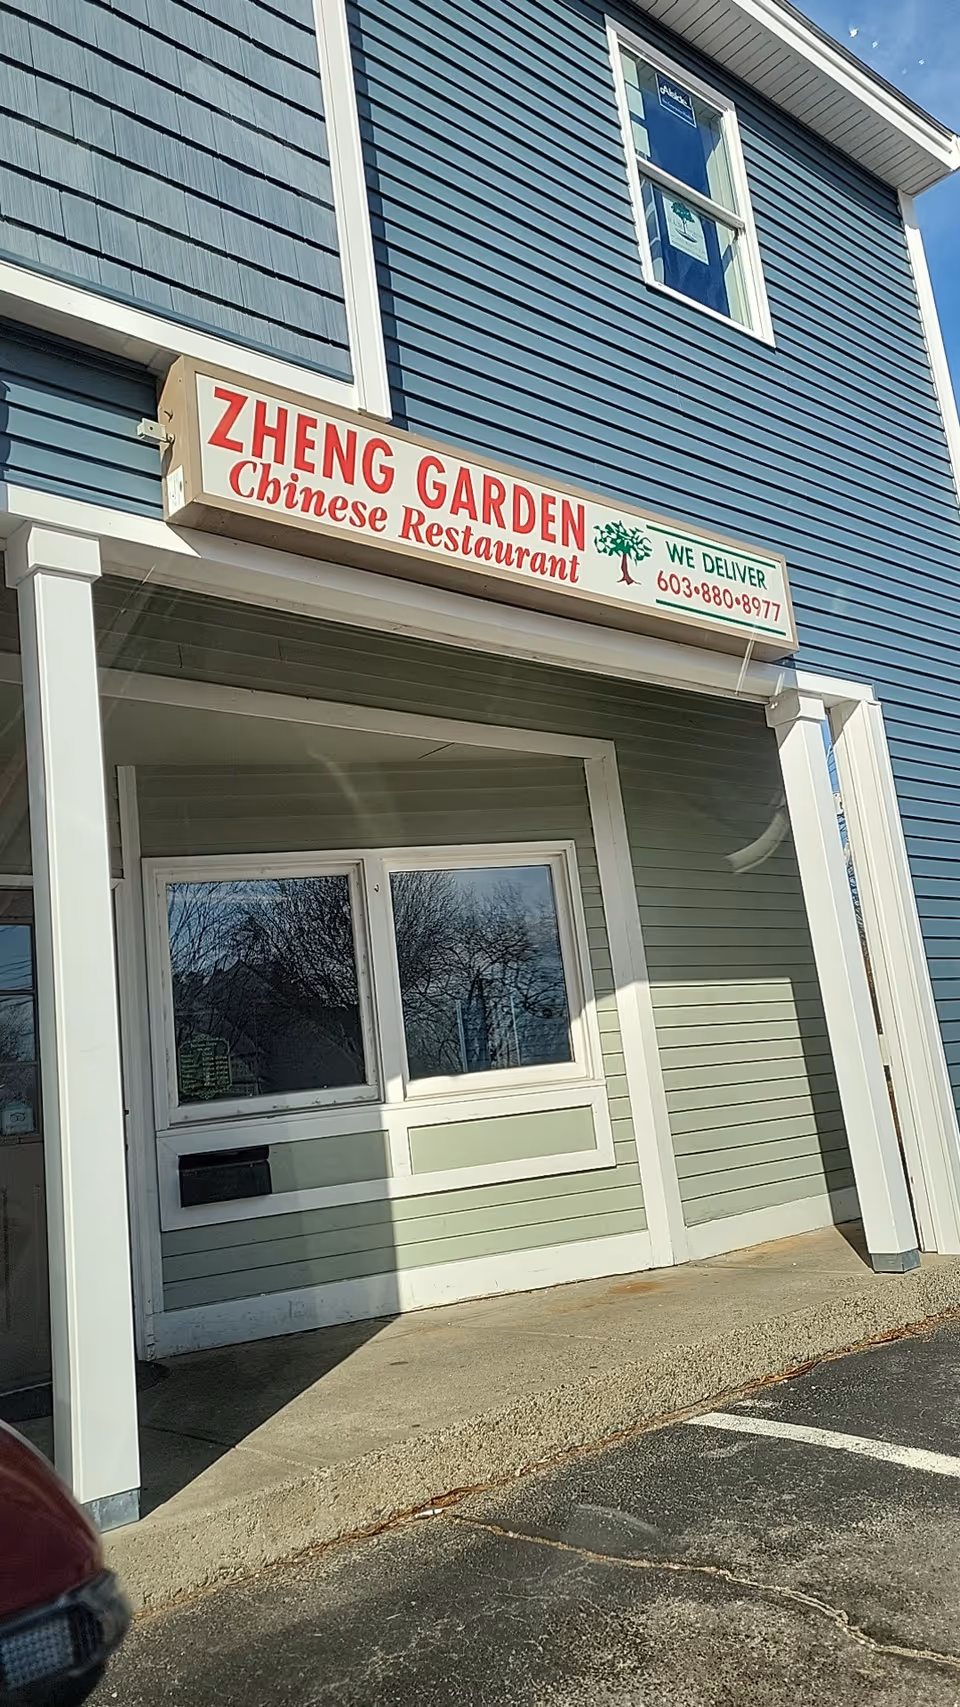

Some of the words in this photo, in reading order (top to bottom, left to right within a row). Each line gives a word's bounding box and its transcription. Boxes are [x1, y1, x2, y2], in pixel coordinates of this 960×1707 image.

[207, 386, 395, 494] ZHENG
[416, 455, 585, 552] GARDEN
[229, 460, 388, 532] Chinese
[398, 505, 580, 583] Restaurant
[665, 540, 695, 569] WE
[702, 552, 767, 590] DELIVER
